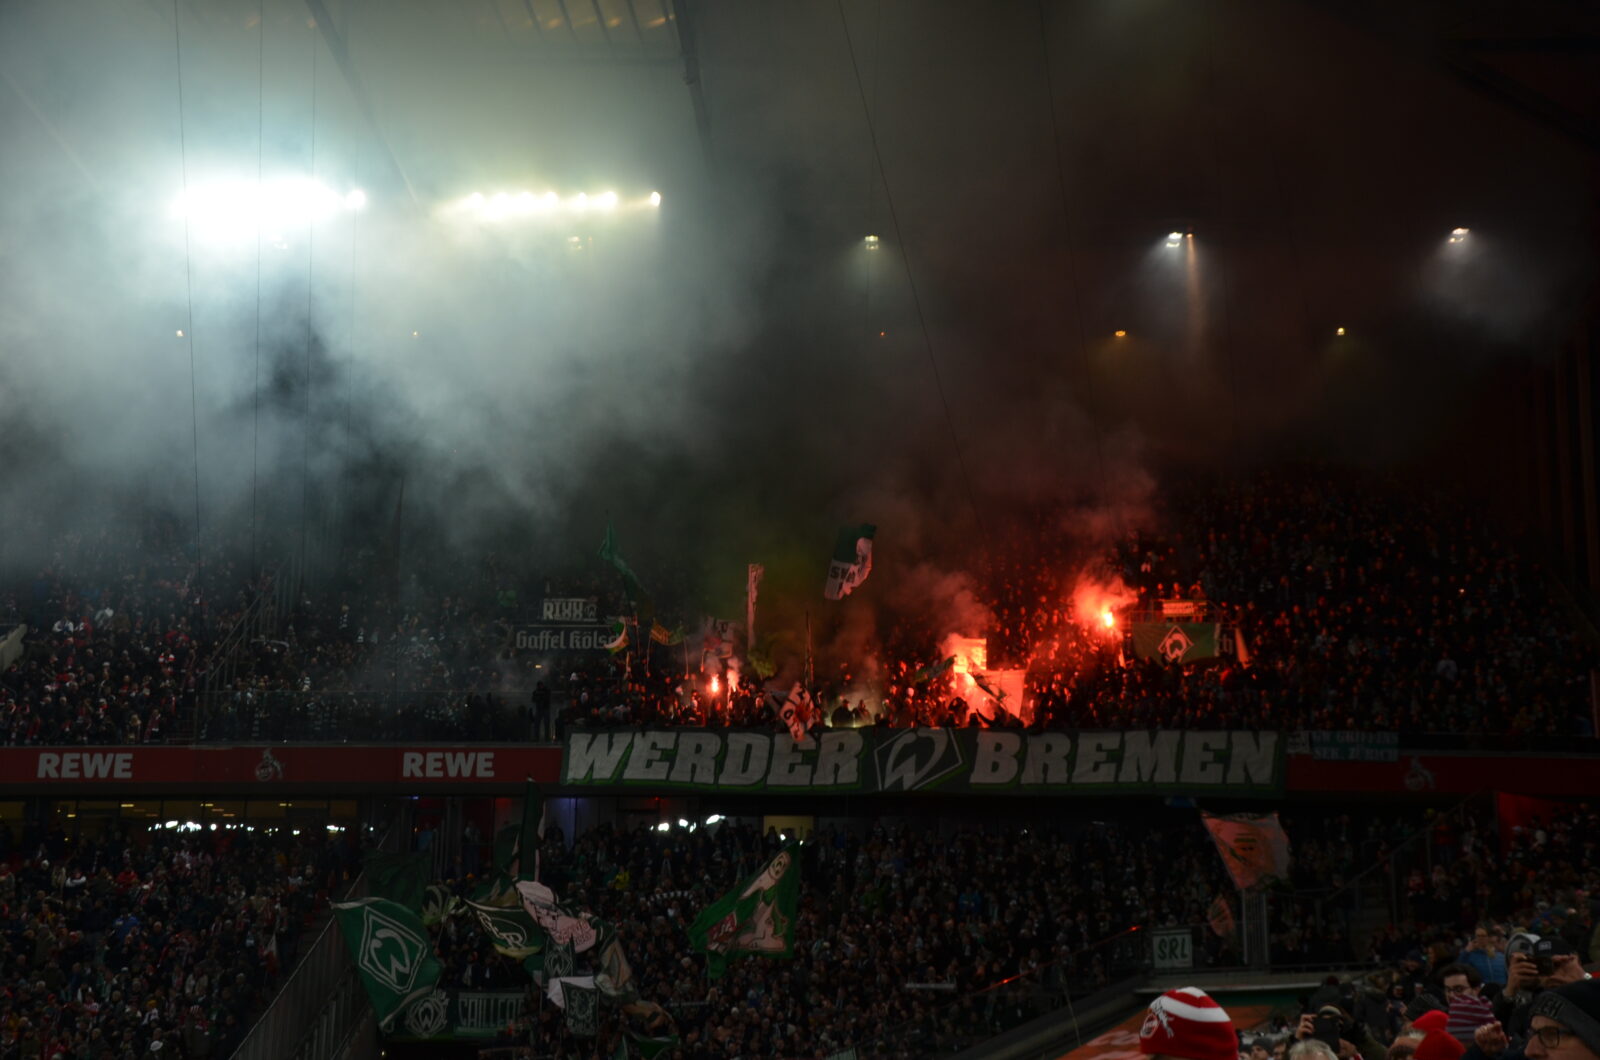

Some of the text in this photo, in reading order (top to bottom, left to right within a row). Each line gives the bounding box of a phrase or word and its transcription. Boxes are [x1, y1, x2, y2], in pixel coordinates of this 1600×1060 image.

[516, 630, 617, 651] Gaffel Kölsc
[37, 752, 133, 779] REWE
[402, 751, 495, 778] REWE
[567, 730, 865, 786] WERDER
[969, 729, 1281, 786] BREMEN
[1158, 938, 1188, 960] SRL
